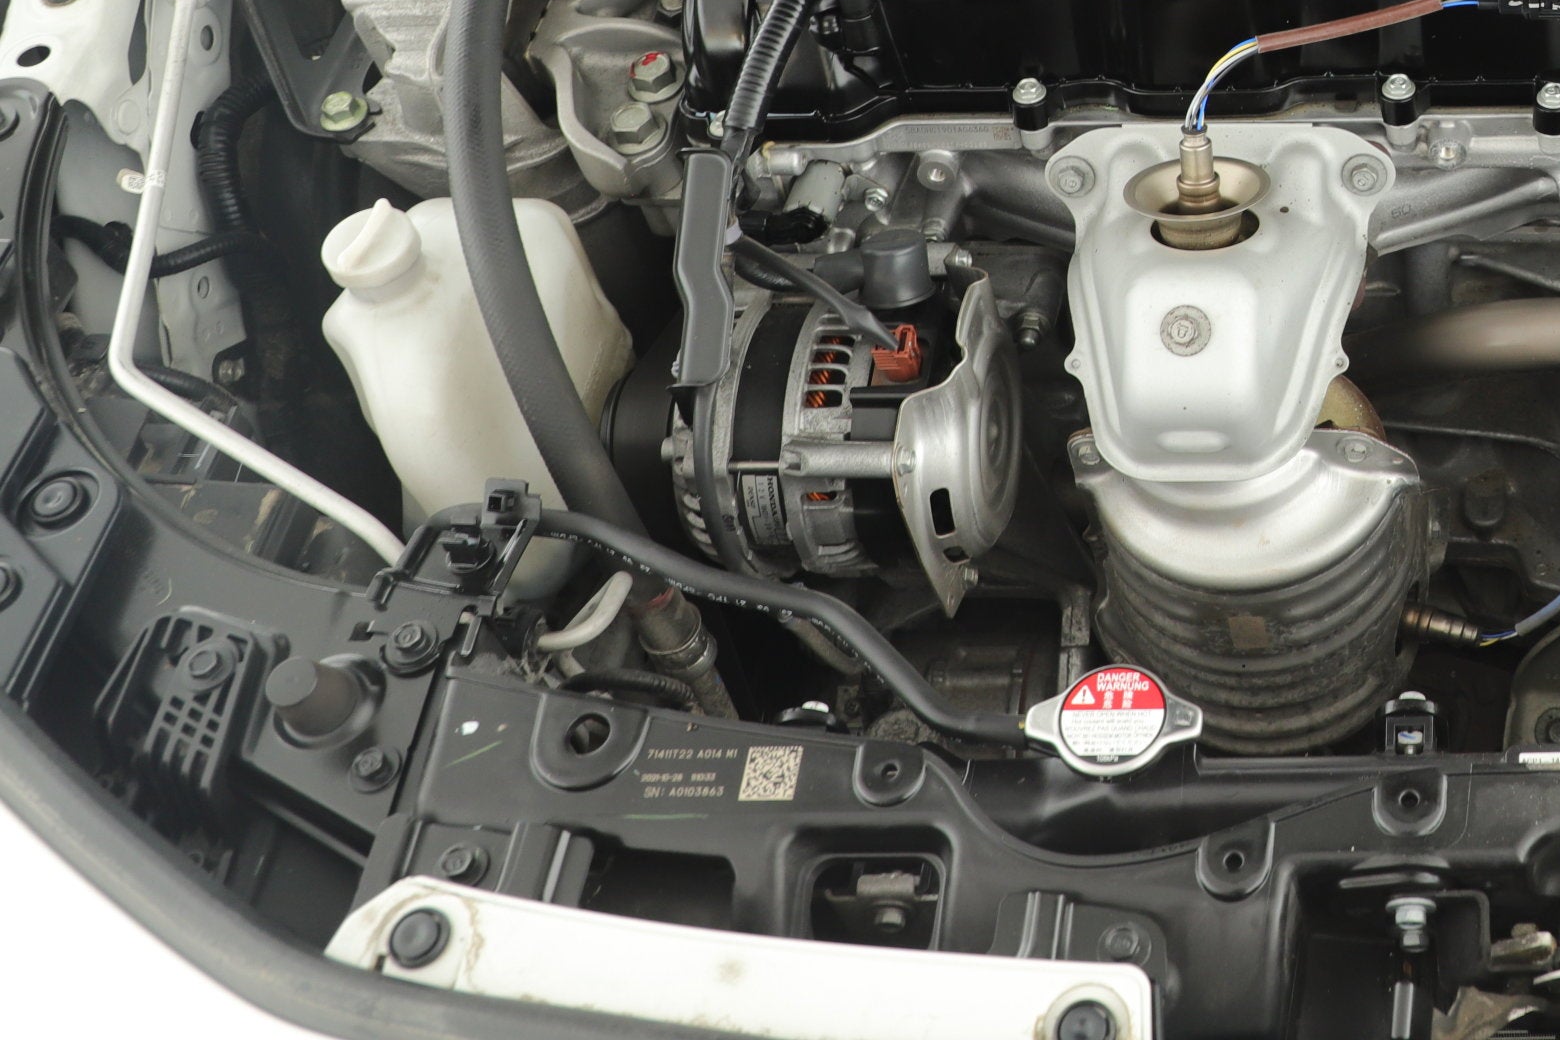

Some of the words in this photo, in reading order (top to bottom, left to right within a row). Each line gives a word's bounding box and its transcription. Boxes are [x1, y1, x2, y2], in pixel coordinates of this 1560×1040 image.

[1097, 672, 1141, 682] DANGER
[1097, 681, 1150, 691] WARNUNG
[696, 748, 723, 759] A014
